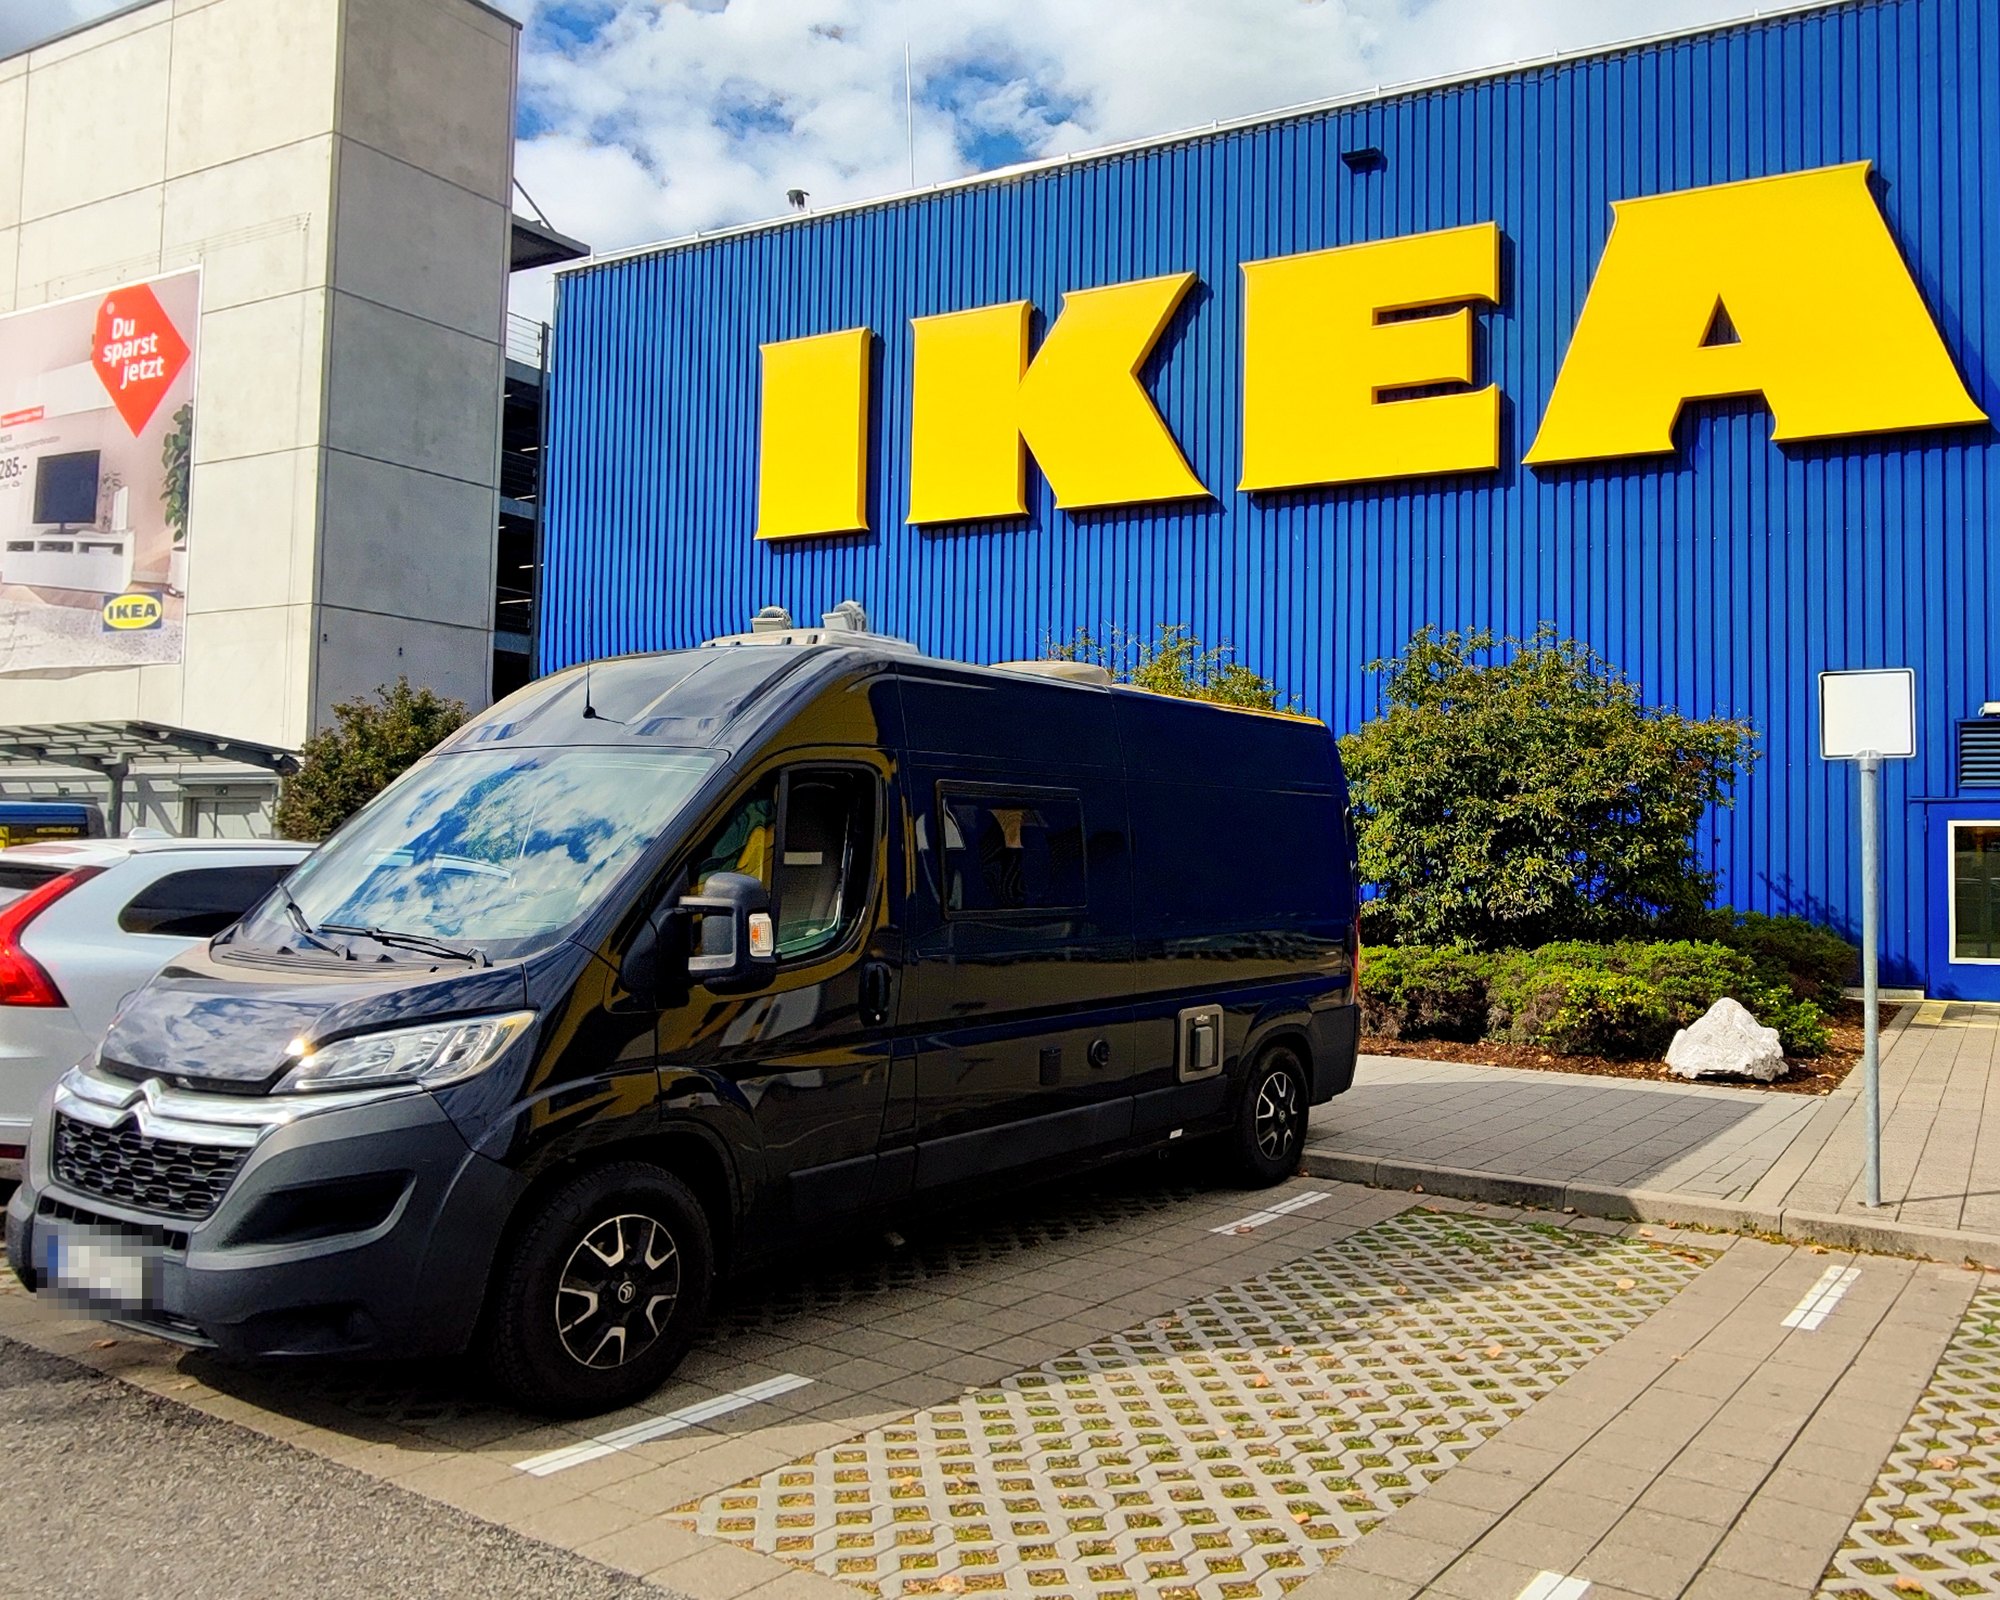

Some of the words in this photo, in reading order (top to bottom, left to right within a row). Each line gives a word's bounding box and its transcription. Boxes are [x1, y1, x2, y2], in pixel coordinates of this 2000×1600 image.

[111, 318, 135, 340] Du
[102, 332, 158, 367] sparst
[754, 159, 1988, 542] IKEA
[119, 356, 164, 389] jetzt
[108, 603, 158, 619] IKEA
